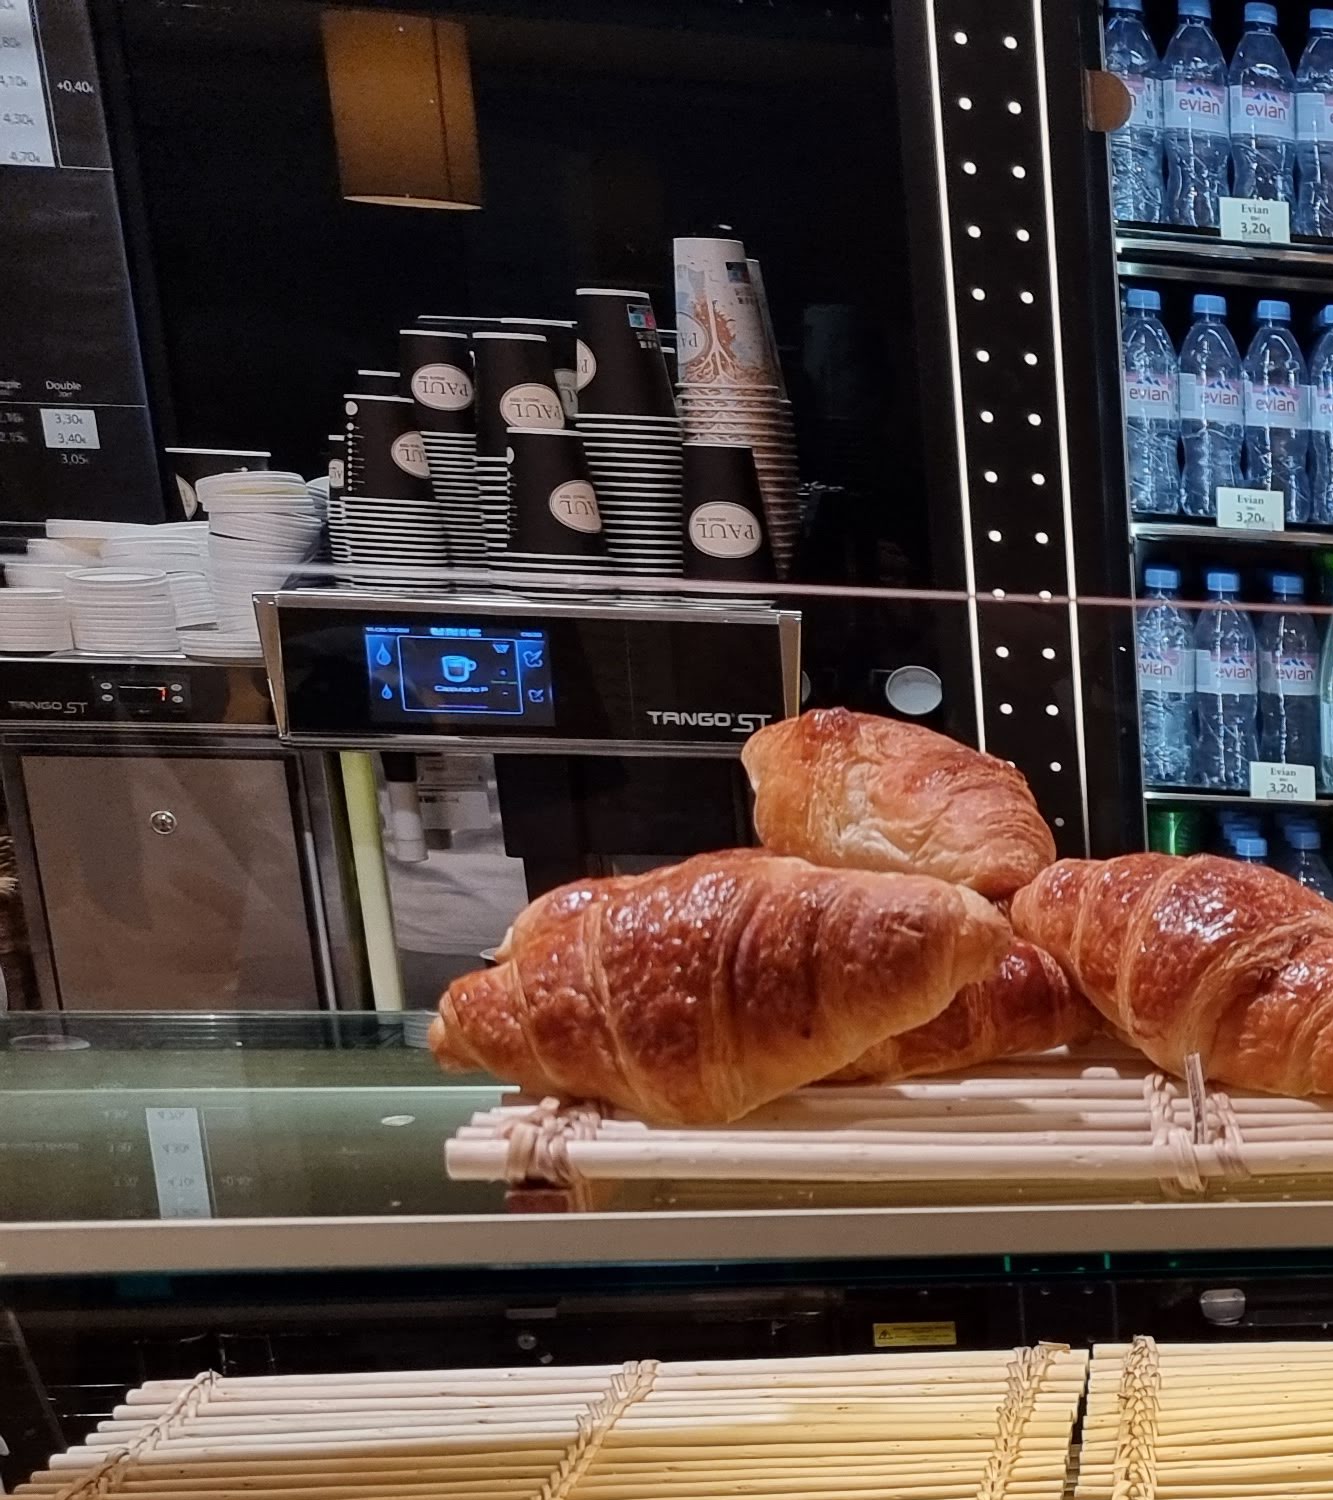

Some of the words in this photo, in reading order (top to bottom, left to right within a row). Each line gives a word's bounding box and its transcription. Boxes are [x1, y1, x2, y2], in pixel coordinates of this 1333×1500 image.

[1179, 97, 1220, 115] evian
[1245, 102, 1286, 121] evian
[1241, 204, 1269, 215] Evian
[1241, 222, 1271, 234] 3,20€
[46, 381, 82, 391] Double
[419, 380, 470, 398] PAUL
[1129, 387, 1170, 401] evian
[1205, 391, 1239, 406] evian
[1256, 398, 1296, 413] evian
[1237, 494, 1264, 505] Evian
[696, 523, 756, 540] PAUL
[1276, 667, 1313, 681] evian
[64, 702, 88, 713] ST
[646, 710, 731, 727] TANGO
[731, 713, 772, 732] ST
[1270, 768, 1296, 777] Evian
